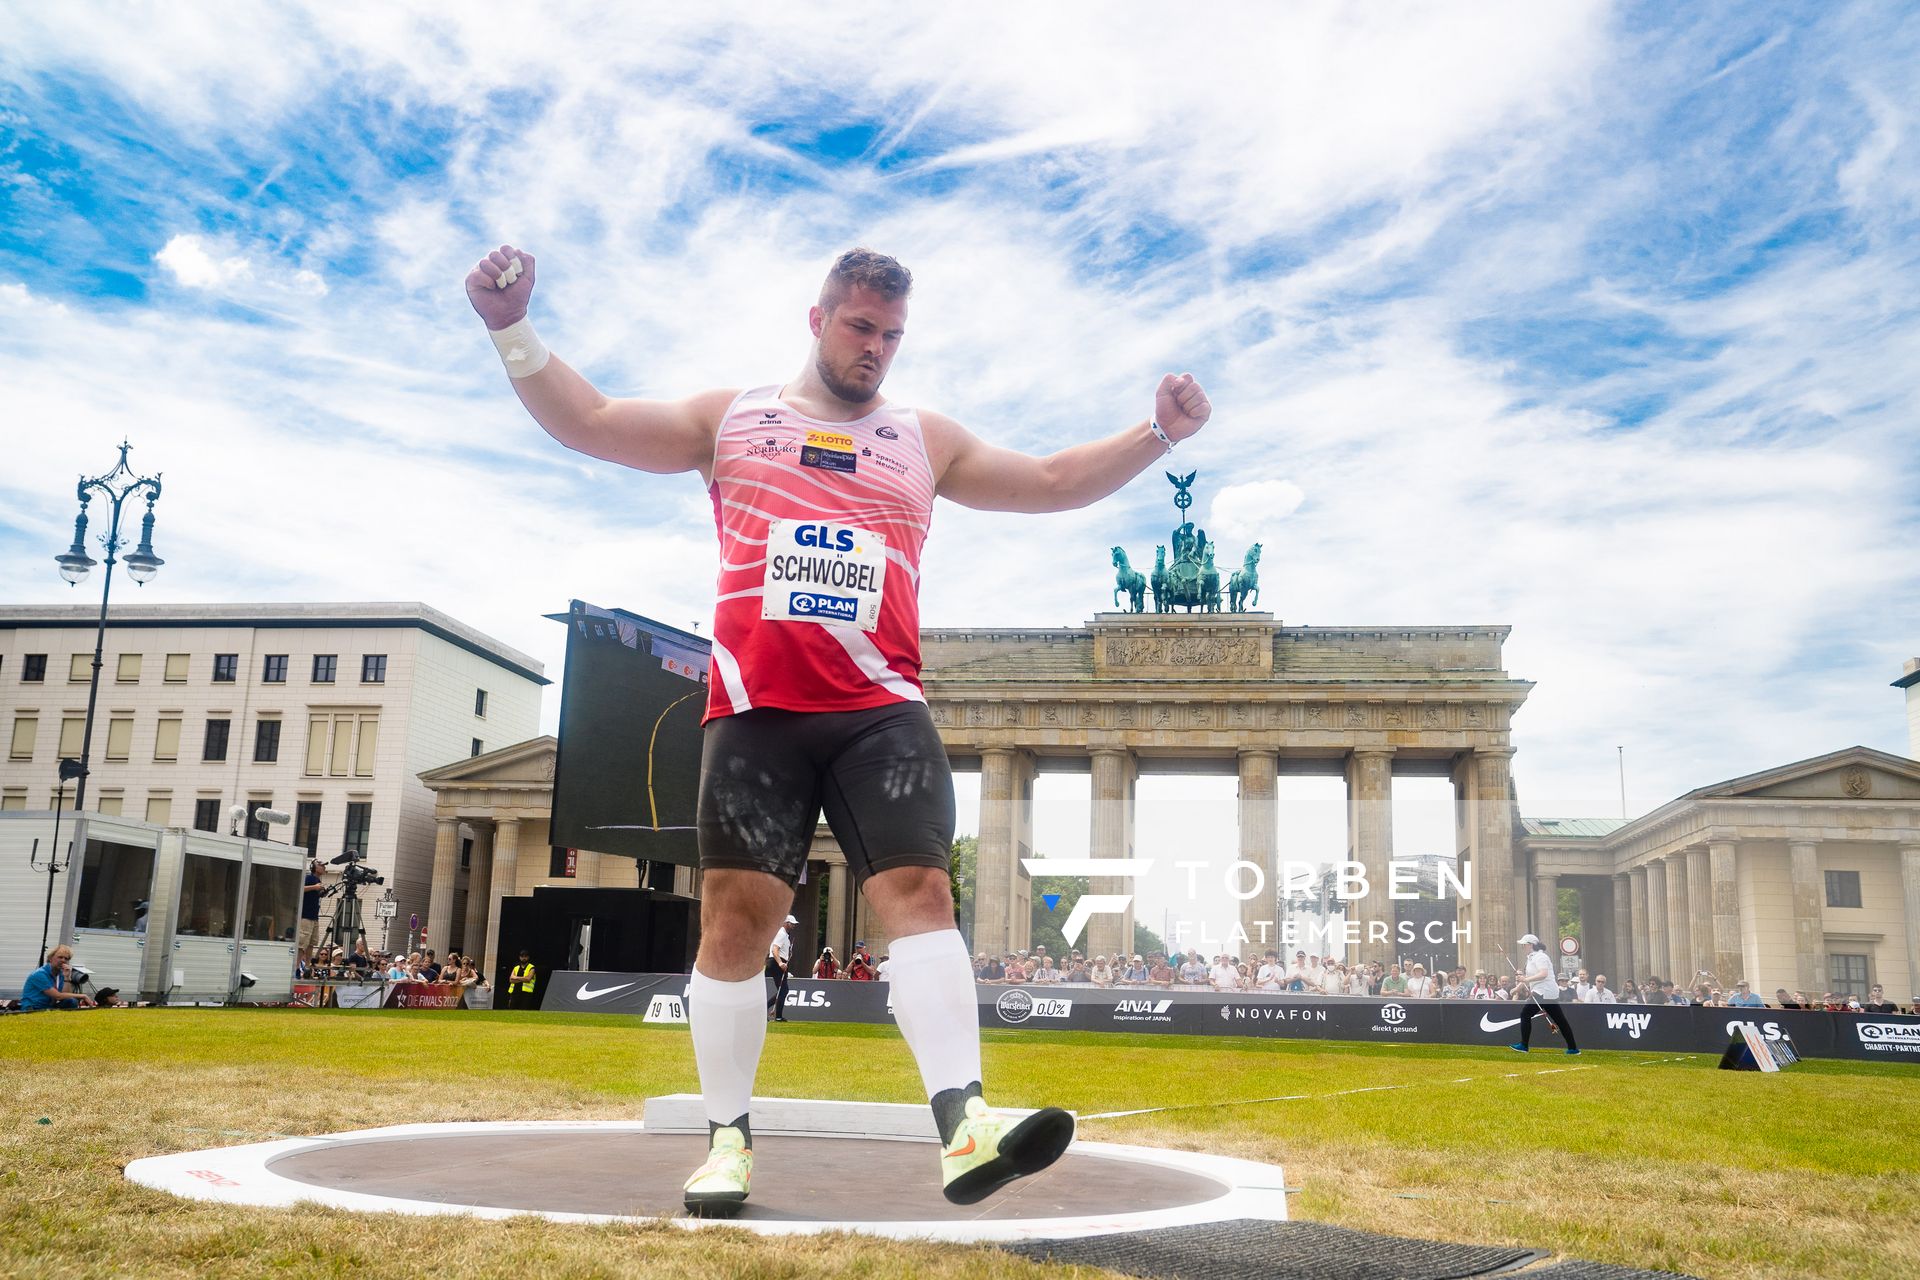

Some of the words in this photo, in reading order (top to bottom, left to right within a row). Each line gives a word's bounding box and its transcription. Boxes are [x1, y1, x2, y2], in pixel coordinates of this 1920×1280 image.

[821, 435, 853, 446] LOTTO
[875, 453, 909, 471] Sparkasse
[771, 554, 878, 593] SCHWÖBEL
[818, 598, 855, 613] PLAN
[817, 610, 854, 619] INTERNATIONAL
[407, 994, 418, 1007] DIE
[418, 995, 442, 1007] FINALS
[442, 996, 459, 1007] 2022
[1114, 1000, 1152, 1013] ANA
[651, 1002, 662, 1018] 19
[669, 1003, 681, 1018] 19
[1037, 1000, 1065, 1015] 0,0%
[1381, 1008, 1406, 1020] BIG
[1236, 1008, 1326, 1021] NOVAFON
[1884, 1027, 1920, 1037] PLAN
